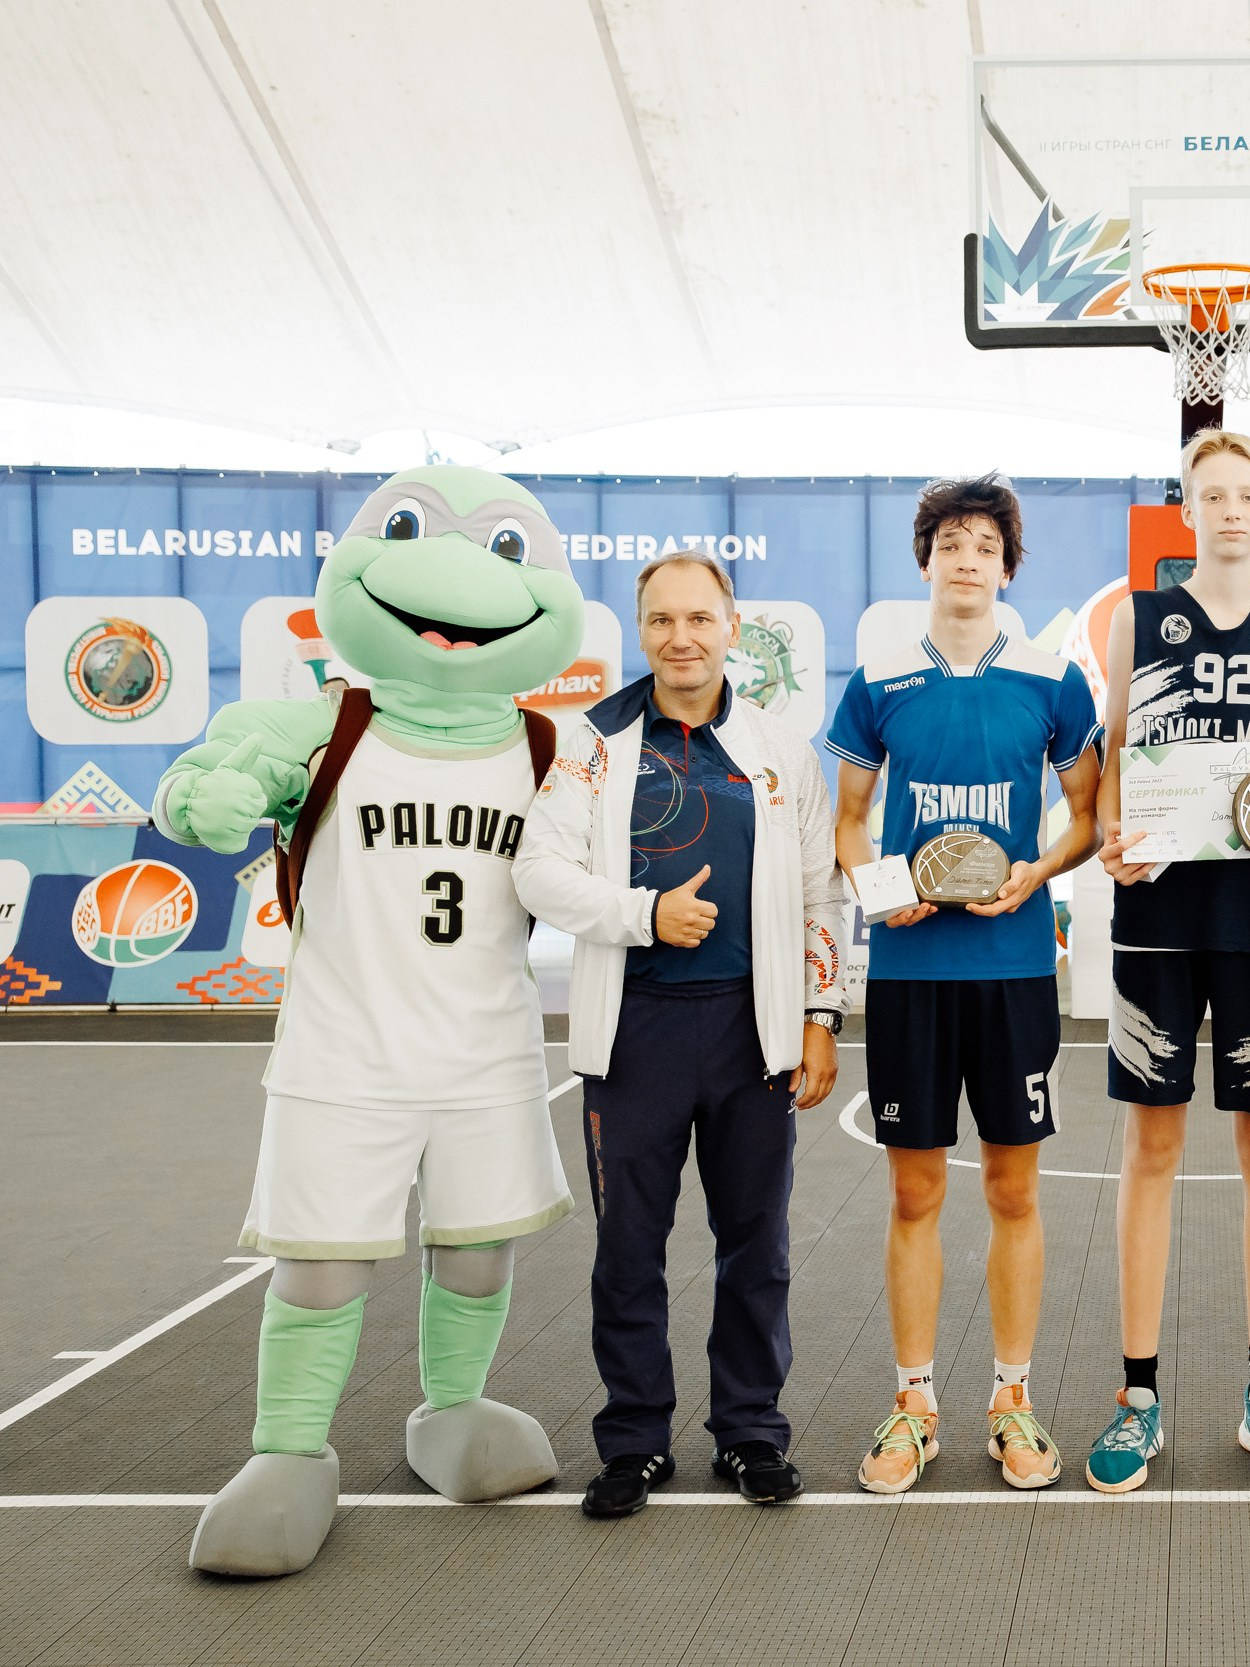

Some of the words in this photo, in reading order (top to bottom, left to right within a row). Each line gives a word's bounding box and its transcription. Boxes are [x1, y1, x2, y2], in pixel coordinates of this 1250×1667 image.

[1051, 140, 1090, 152] ИГРЫ
[1094, 139, 1141, 151] СТРАН
[1144, 138, 1172, 150] СНГ
[72, 528, 302, 557] BELARUSIAN
[884, 676, 926, 693] macron
[909, 780, 1015, 836] TSMOKI
[1128, 786, 1207, 800] СЕРТИФИКАТ
[356, 802, 526, 861] PALOVA
[140, 889, 190, 936] BBF
[421, 869, 465, 947] 3
[1025, 1071, 1045, 1124] 5
